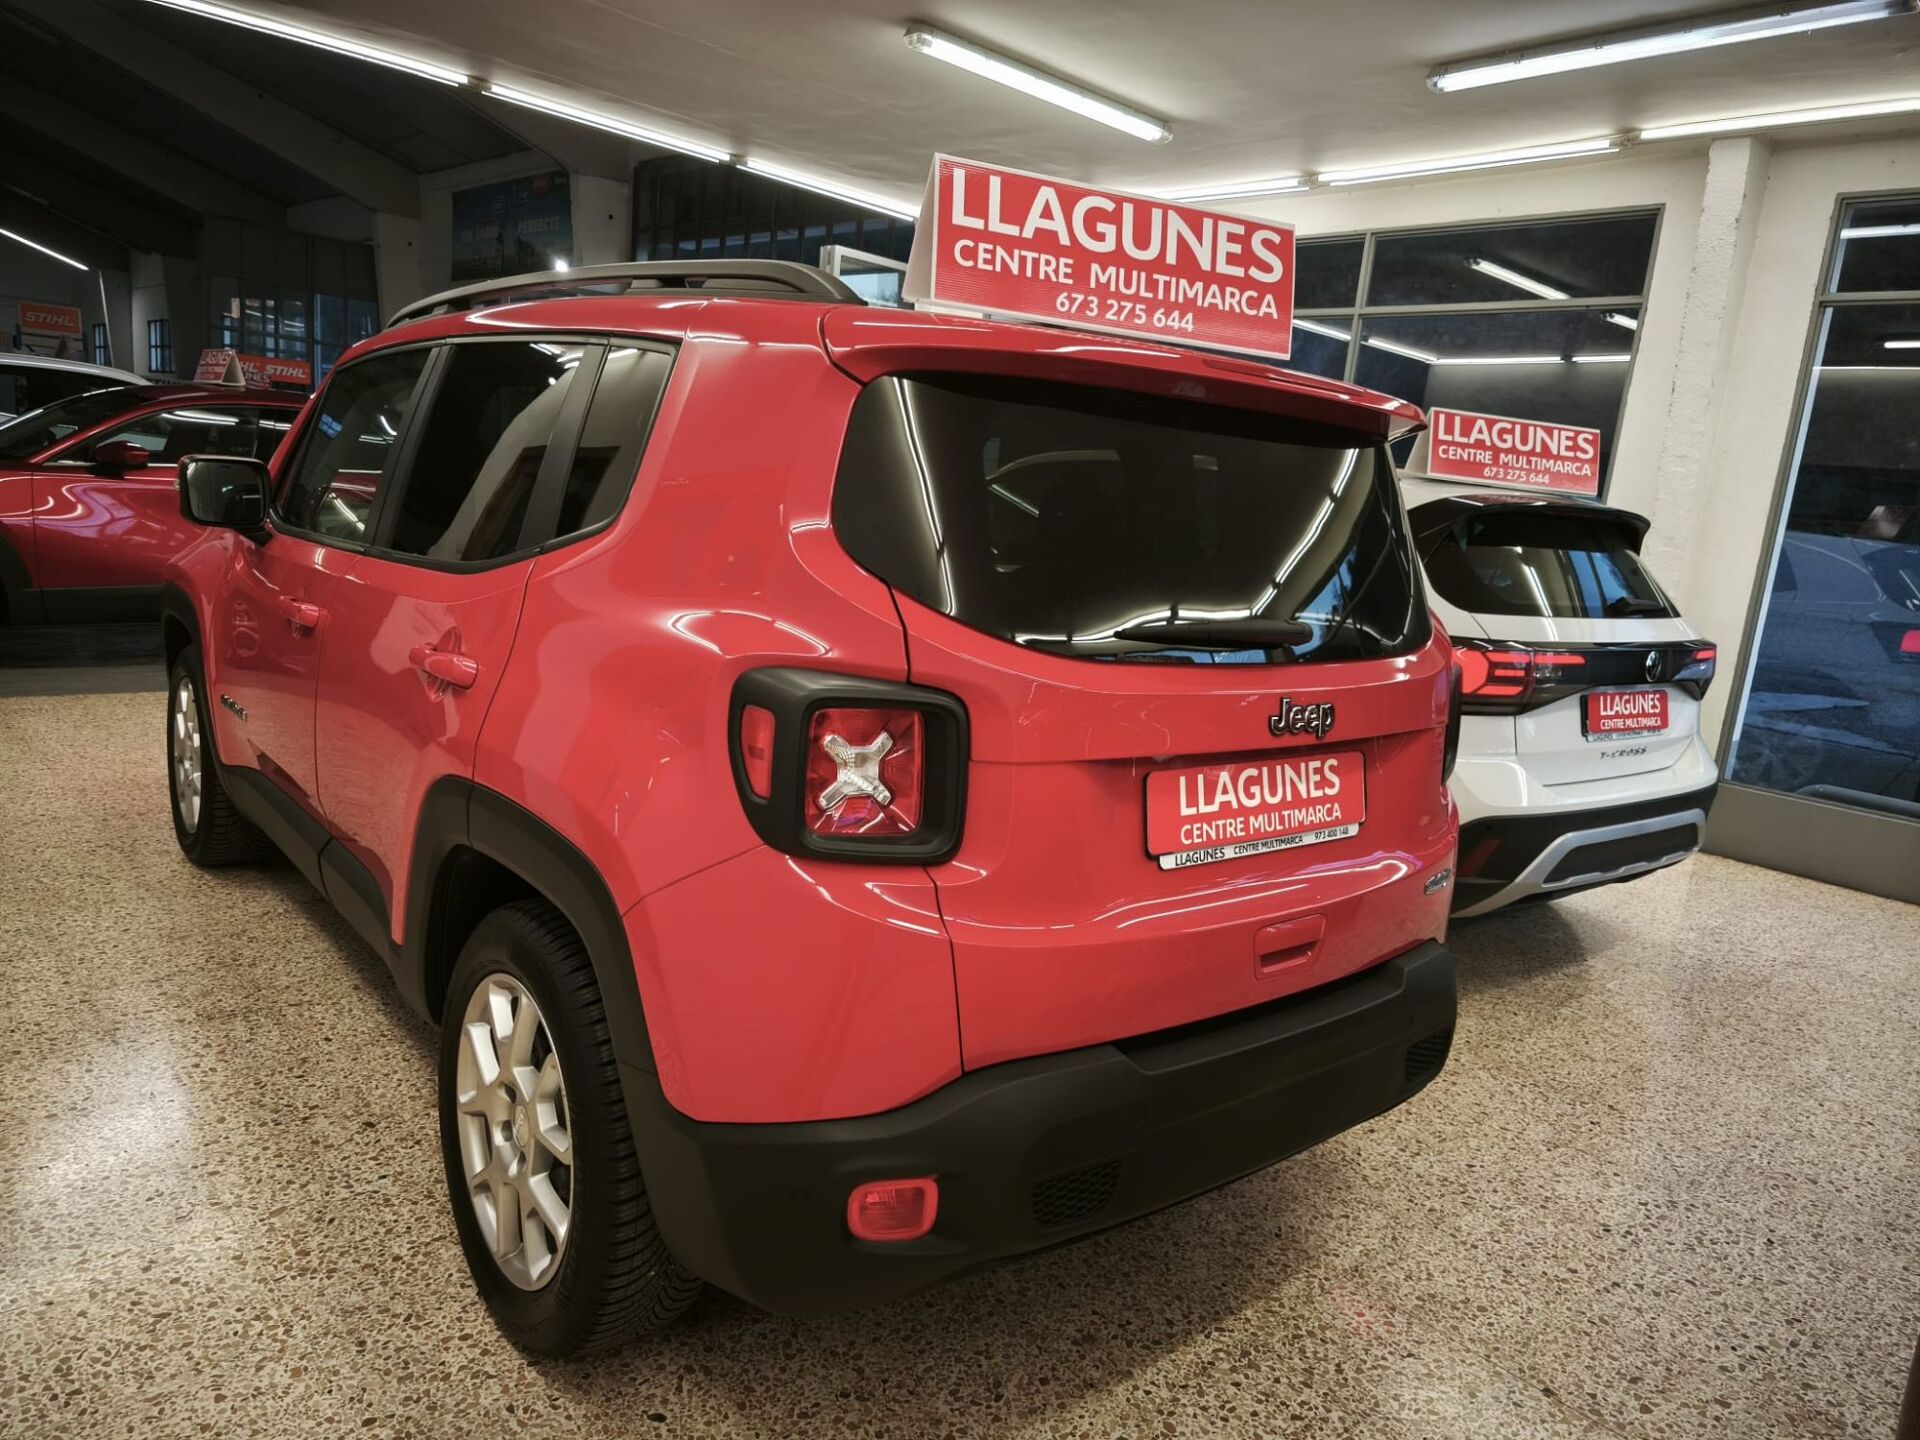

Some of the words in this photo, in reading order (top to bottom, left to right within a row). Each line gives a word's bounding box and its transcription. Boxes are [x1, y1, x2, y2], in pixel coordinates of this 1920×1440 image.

[952, 168, 1284, 283] LLAGUNES
[954, 240, 1074, 285] CENTRE
[1090, 263, 1279, 319] MULTIMARCA
[24, 312, 74, 327] STIHL
[1056, 292, 1099, 317] 673
[1106, 299, 1147, 324] 275
[1153, 308, 1194, 332] 644
[265, 364, 307, 378] STIHL
[1437, 413, 1594, 460] LLAGUNES
[1438, 445, 1493, 464] CENTRE
[1500, 454, 1591, 477] MULTIMARCA
[1483, 467, 1504, 479] 673
[1507, 469, 1527, 482] 275
[1529, 472, 1550, 485] 644
[1268, 697, 1336, 739] Jeep
[1600, 694, 1661, 716] LLAGUNES
[1600, 717, 1624, 730] CENTRE
[1625, 715, 1661, 729] MULTIMARCA
[1179, 758, 1340, 817] LLAGUNES
[1180, 816, 1245, 845] CENTRE
[1250, 802, 1342, 837] MULTIMARCA
[1175, 847, 1225, 867] LLAGUNES
[1233, 842, 1260, 855] CENTRE
[1260, 835, 1304, 850] MULTIMARCA
[1314, 829, 1326, 840] 973
